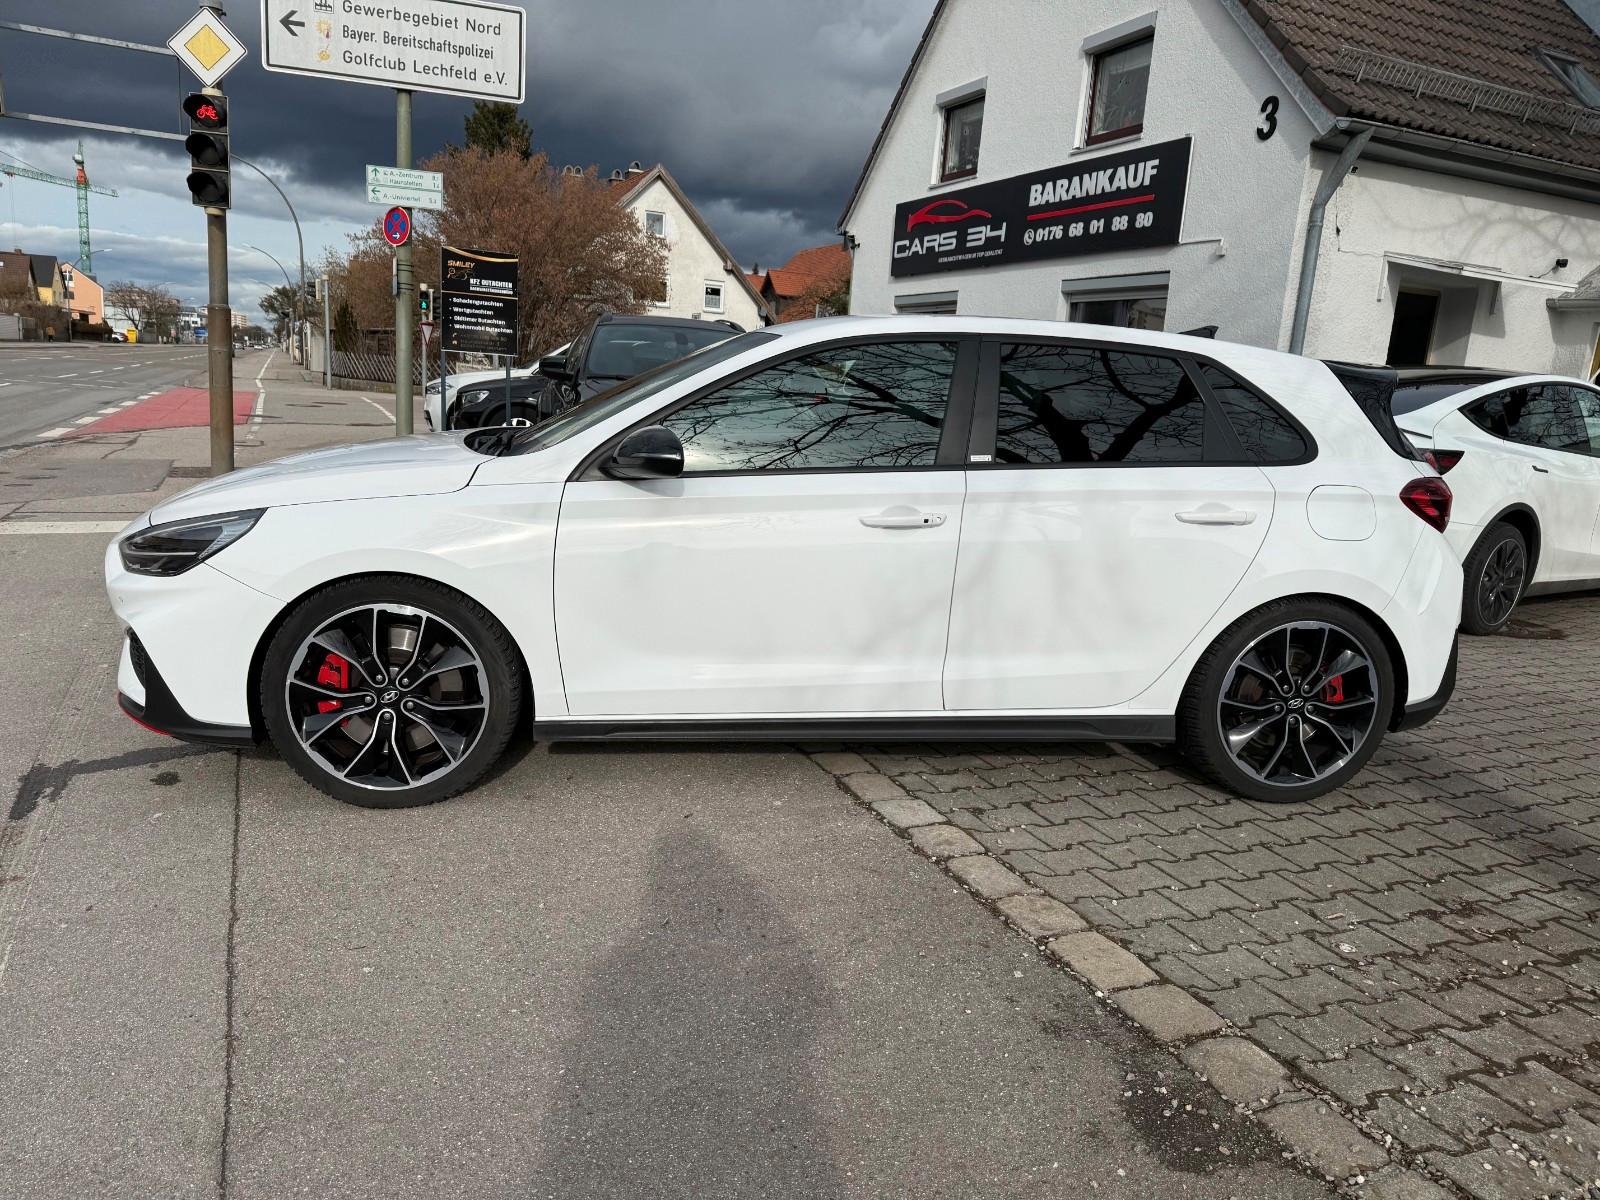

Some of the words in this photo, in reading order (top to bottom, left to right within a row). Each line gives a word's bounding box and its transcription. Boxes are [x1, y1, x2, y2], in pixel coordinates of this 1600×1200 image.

[343, 0, 458, 29] Gewerbegebiet
[466, 18, 501, 36] Nord
[342, 24, 377, 43] Bayer.
[383, 31, 494, 60] Bereitschaftspolizei
[343, 50, 406, 71] Golfclub
[413, 59, 477, 81] Lechfeld
[484, 71, 508, 87] e.V.
[1257, 95, 1280, 141] 3
[1028, 158, 1160, 207] BARANKAUF
[894, 230, 958, 259] CARS
[966, 221, 1007, 248] 34
[1035, 225, 1063, 242] 0176
[1068, 221, 1084, 238] 68
[1089, 218, 1105, 235] 01
[1111, 215, 1129, 232] 88
[1135, 211, 1154, 229] 80
[447, 259, 475, 269] SMILEY
[469, 277, 480, 286] KFZ
[481, 279, 513, 289] GUTACHTEN
[452, 297, 504, 307] Schadengutachten
[452, 306, 494, 315] Wertgutachten
[453, 315, 477, 323] Oldtimer
[478, 317, 506, 326] Gutachten
[485, 326, 513, 334] Gutachten
